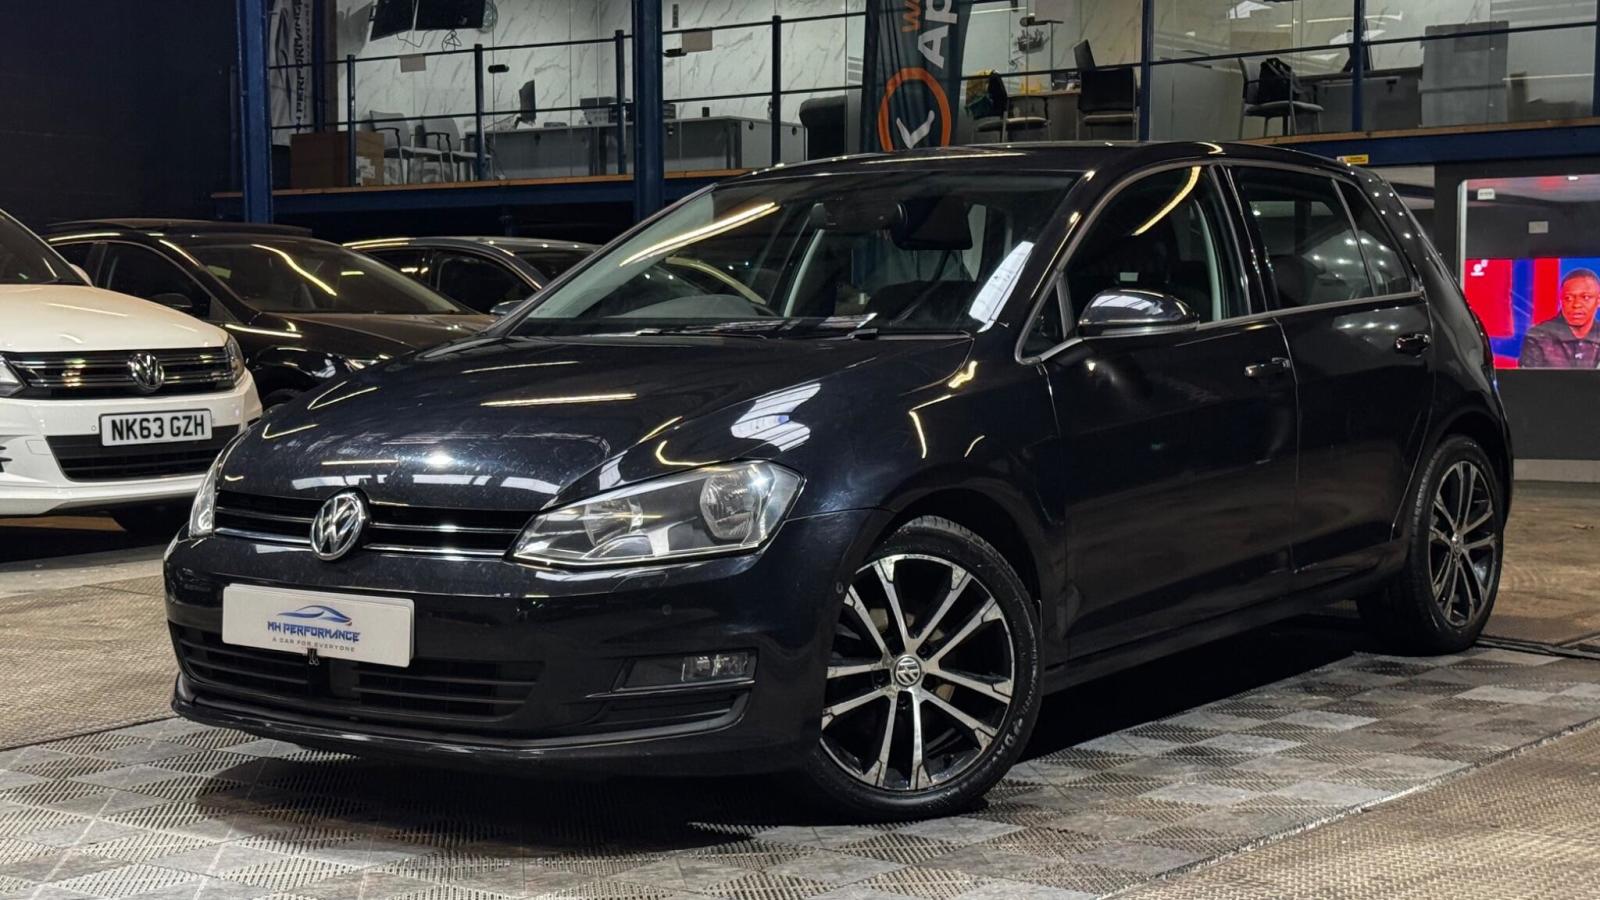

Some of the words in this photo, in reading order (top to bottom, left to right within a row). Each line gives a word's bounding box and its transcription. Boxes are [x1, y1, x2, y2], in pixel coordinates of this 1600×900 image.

[111, 417, 165, 441] NK63
[170, 414, 205, 437] GZH
[267, 621, 282, 633] MH
[283, 622, 361, 643] PERFORMANCE
[314, 643, 355, 652] EVERYONE
